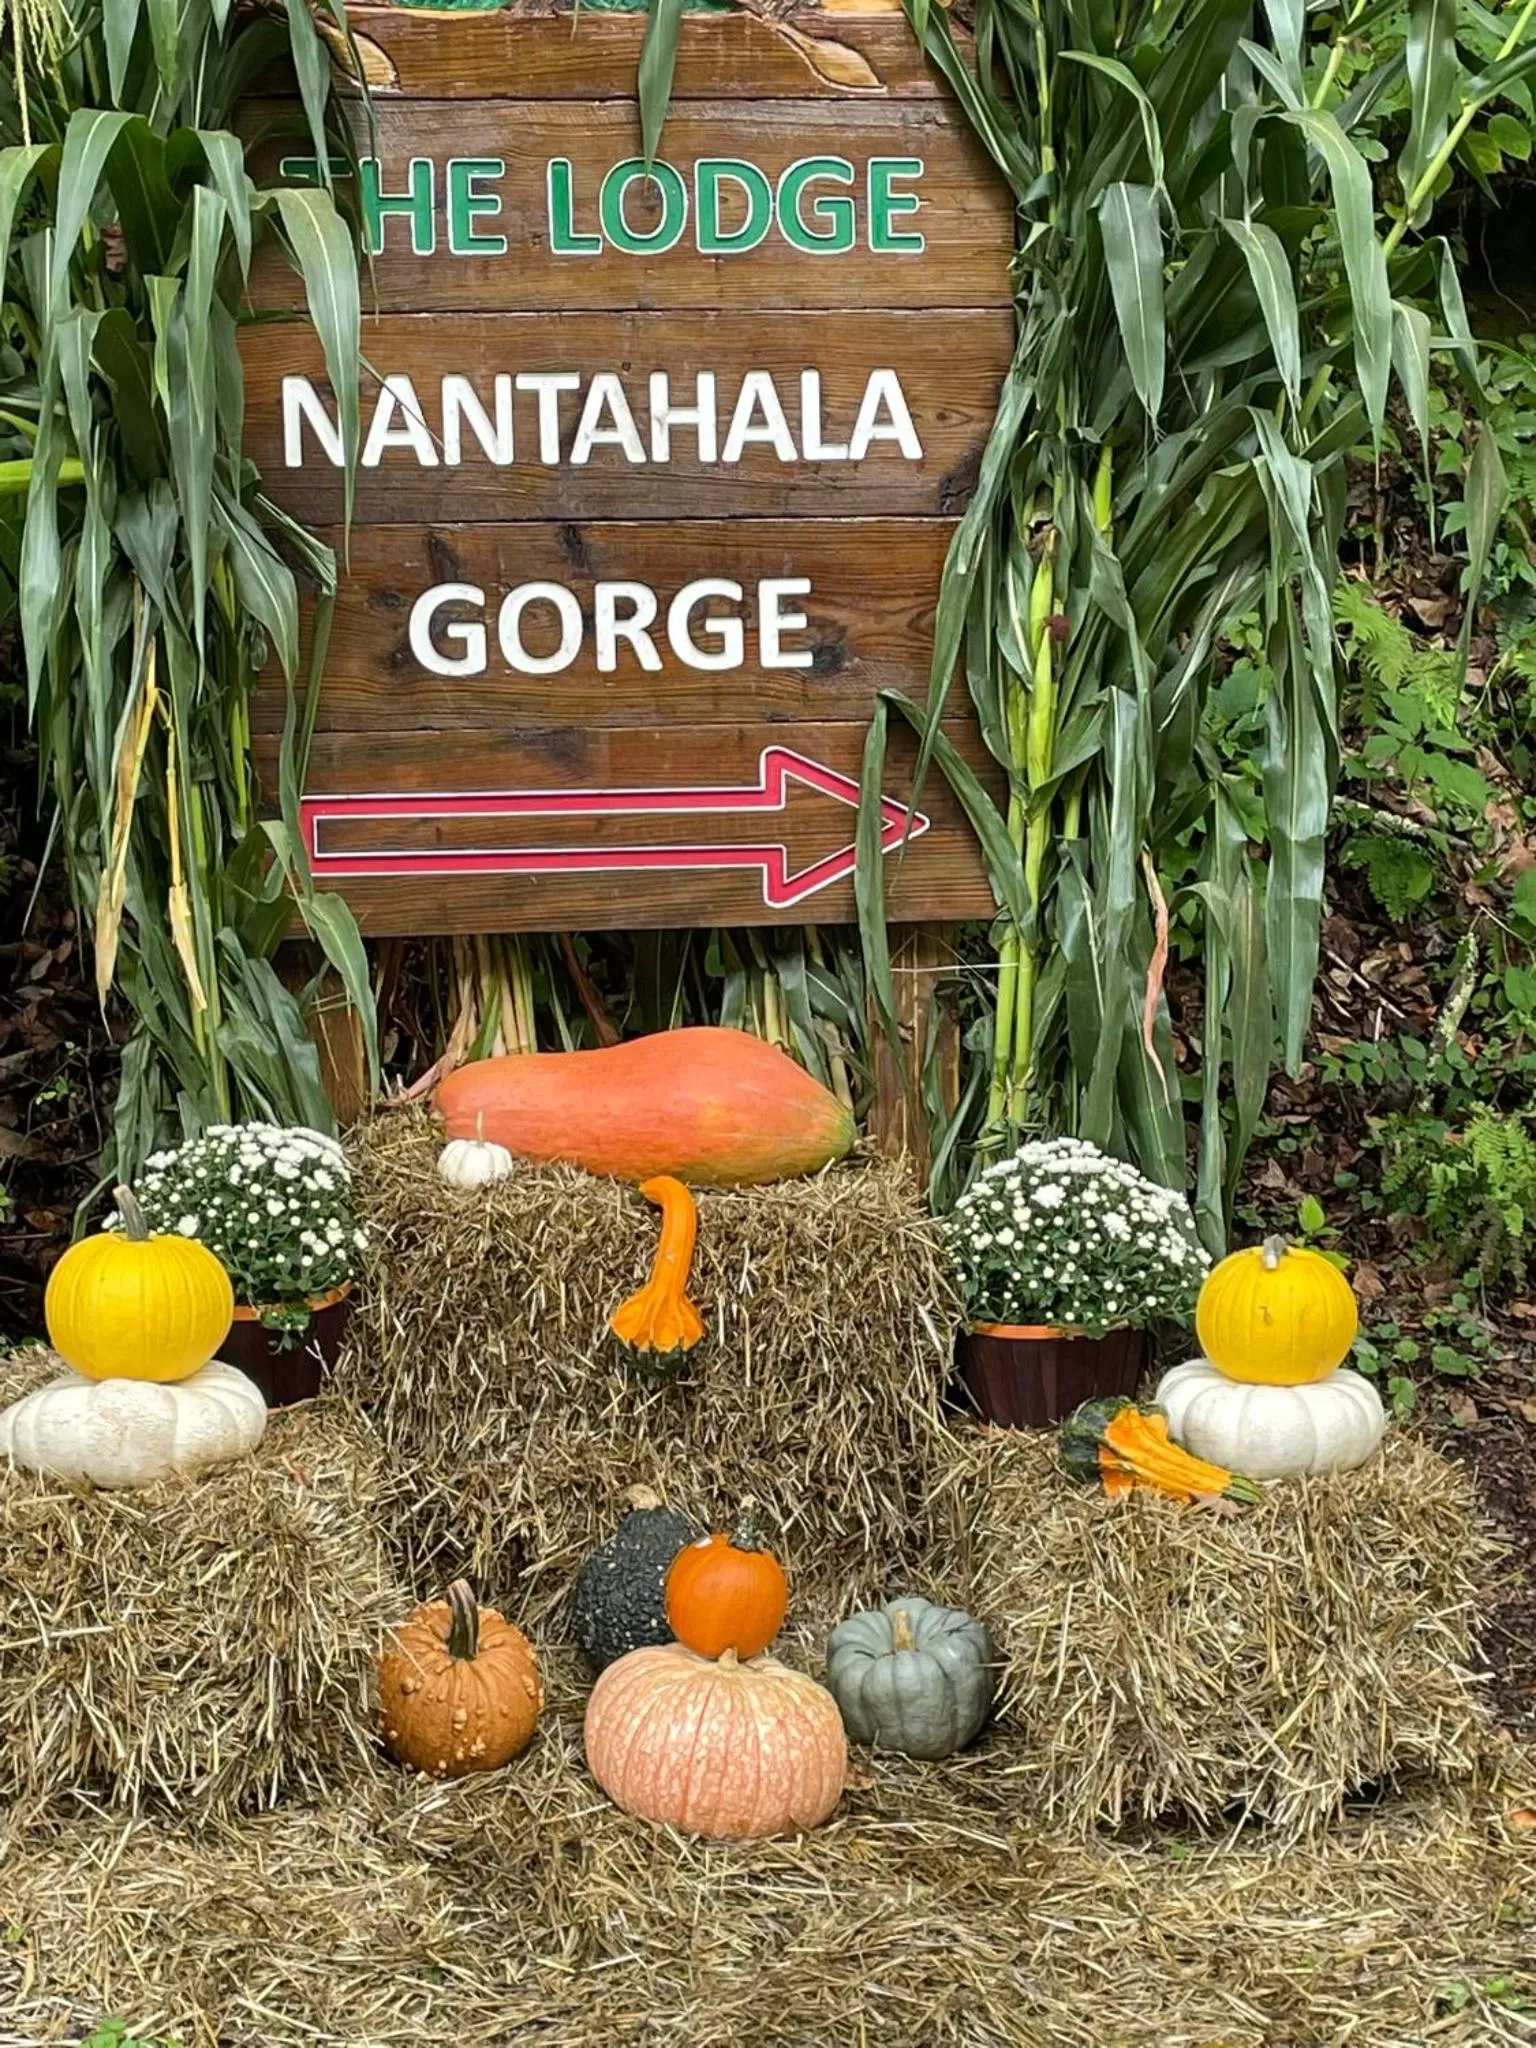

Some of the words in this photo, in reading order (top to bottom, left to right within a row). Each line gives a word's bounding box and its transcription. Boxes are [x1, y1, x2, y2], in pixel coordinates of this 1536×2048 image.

[547, 156, 925, 255] LODGE
[281, 369, 924, 467] NANTAHALA
[408, 577, 814, 676] GORGE
